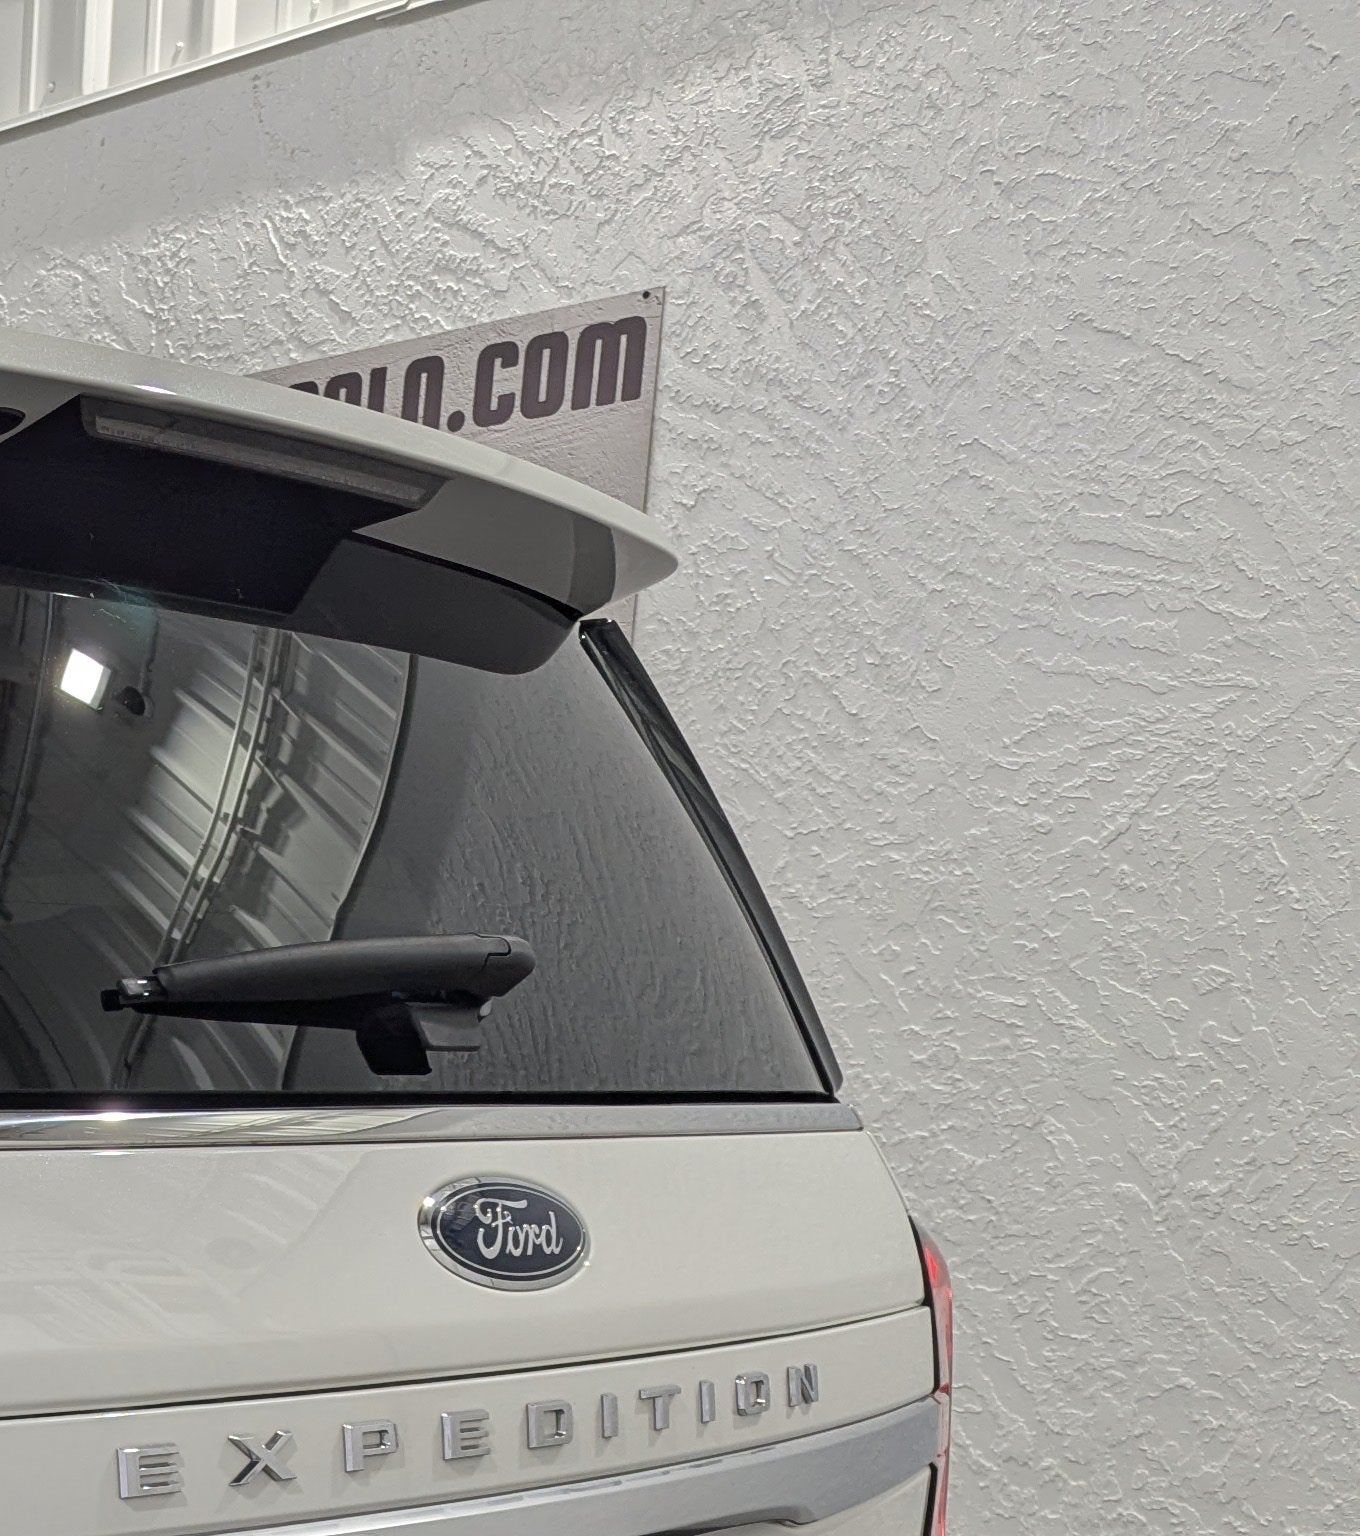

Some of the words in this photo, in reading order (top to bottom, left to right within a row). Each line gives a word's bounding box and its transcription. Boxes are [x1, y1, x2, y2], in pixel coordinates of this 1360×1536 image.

[288, 315, 648, 432] N.COM
[473, 1197, 564, 1260] Ford
[115, 1362, 821, 1500] EXPEDITION
